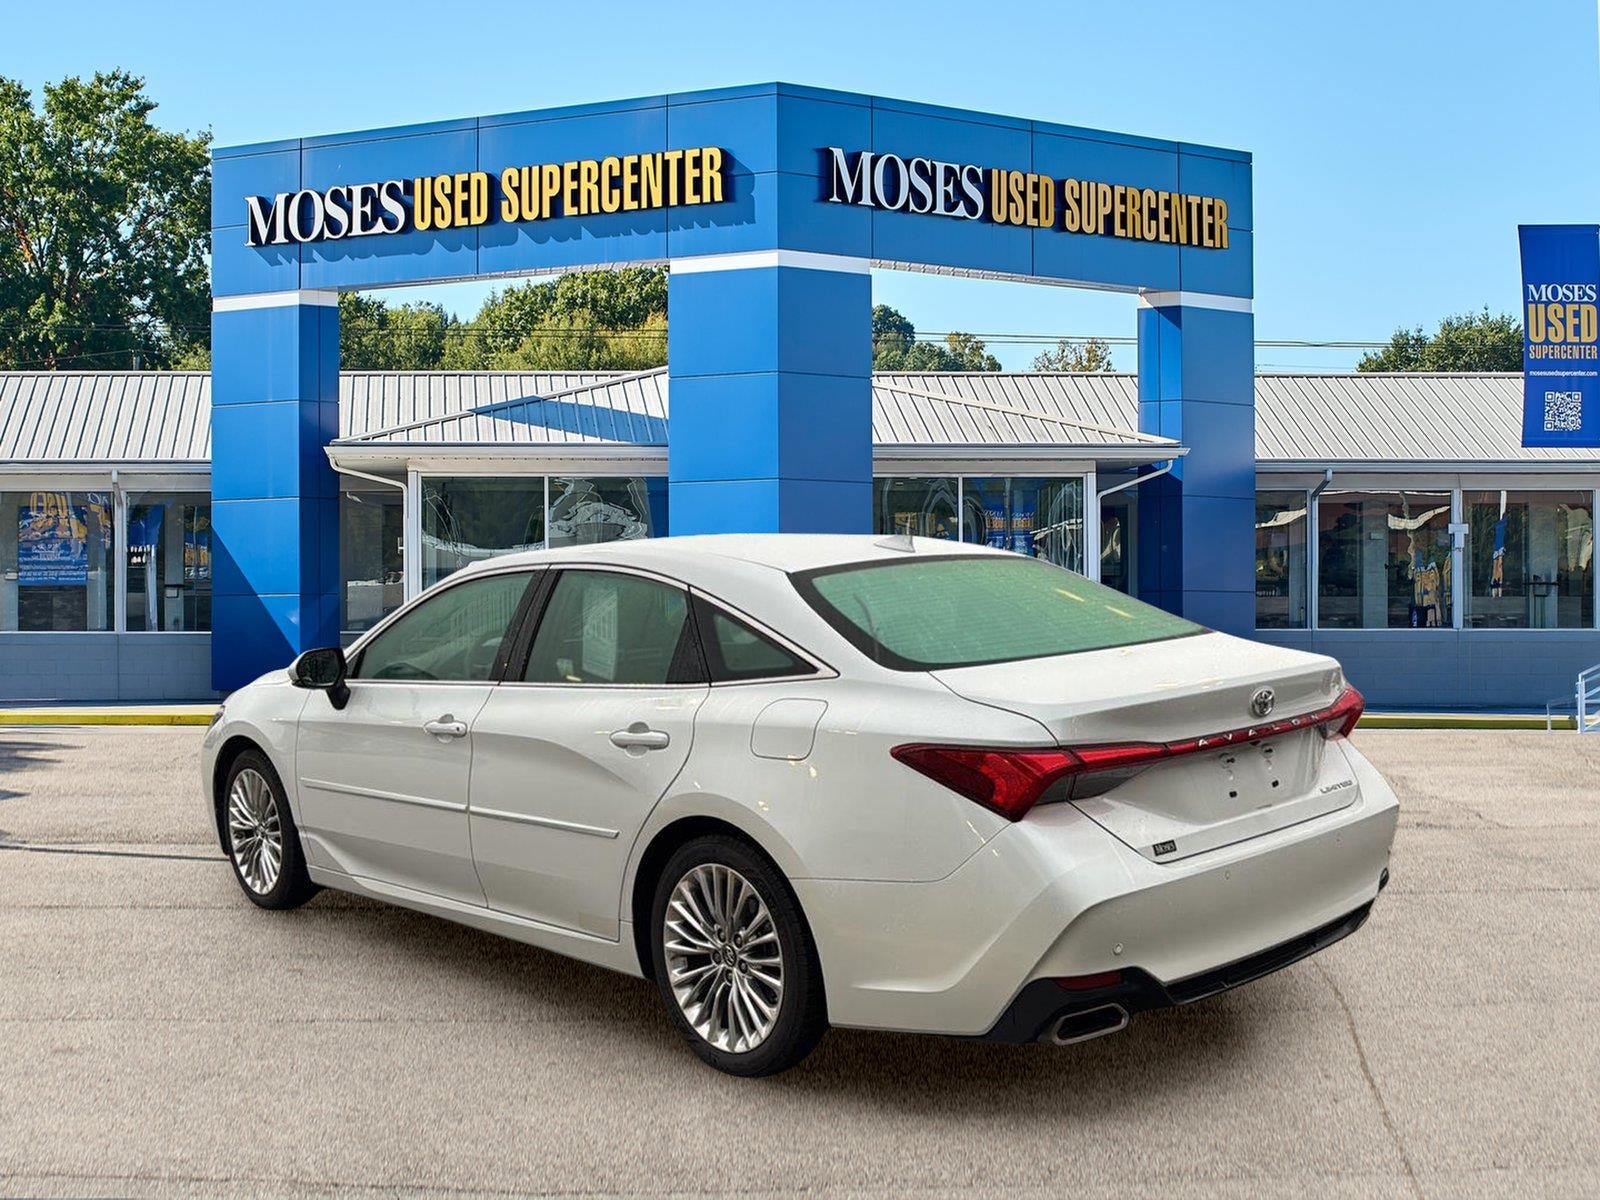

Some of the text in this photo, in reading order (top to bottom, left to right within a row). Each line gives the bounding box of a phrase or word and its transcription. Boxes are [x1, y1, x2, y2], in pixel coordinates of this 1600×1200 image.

[245, 146, 724, 247] MOSES USED SUPERCENTER
[828, 146, 1229, 250] MOSES USED SUPERCENTER
[1527, 284, 1597, 301] MOSES
[1528, 303, 1598, 343] USED
[1529, 345, 1598, 360] SUPERCENTER
[1199, 714, 1320, 747] AVALON
